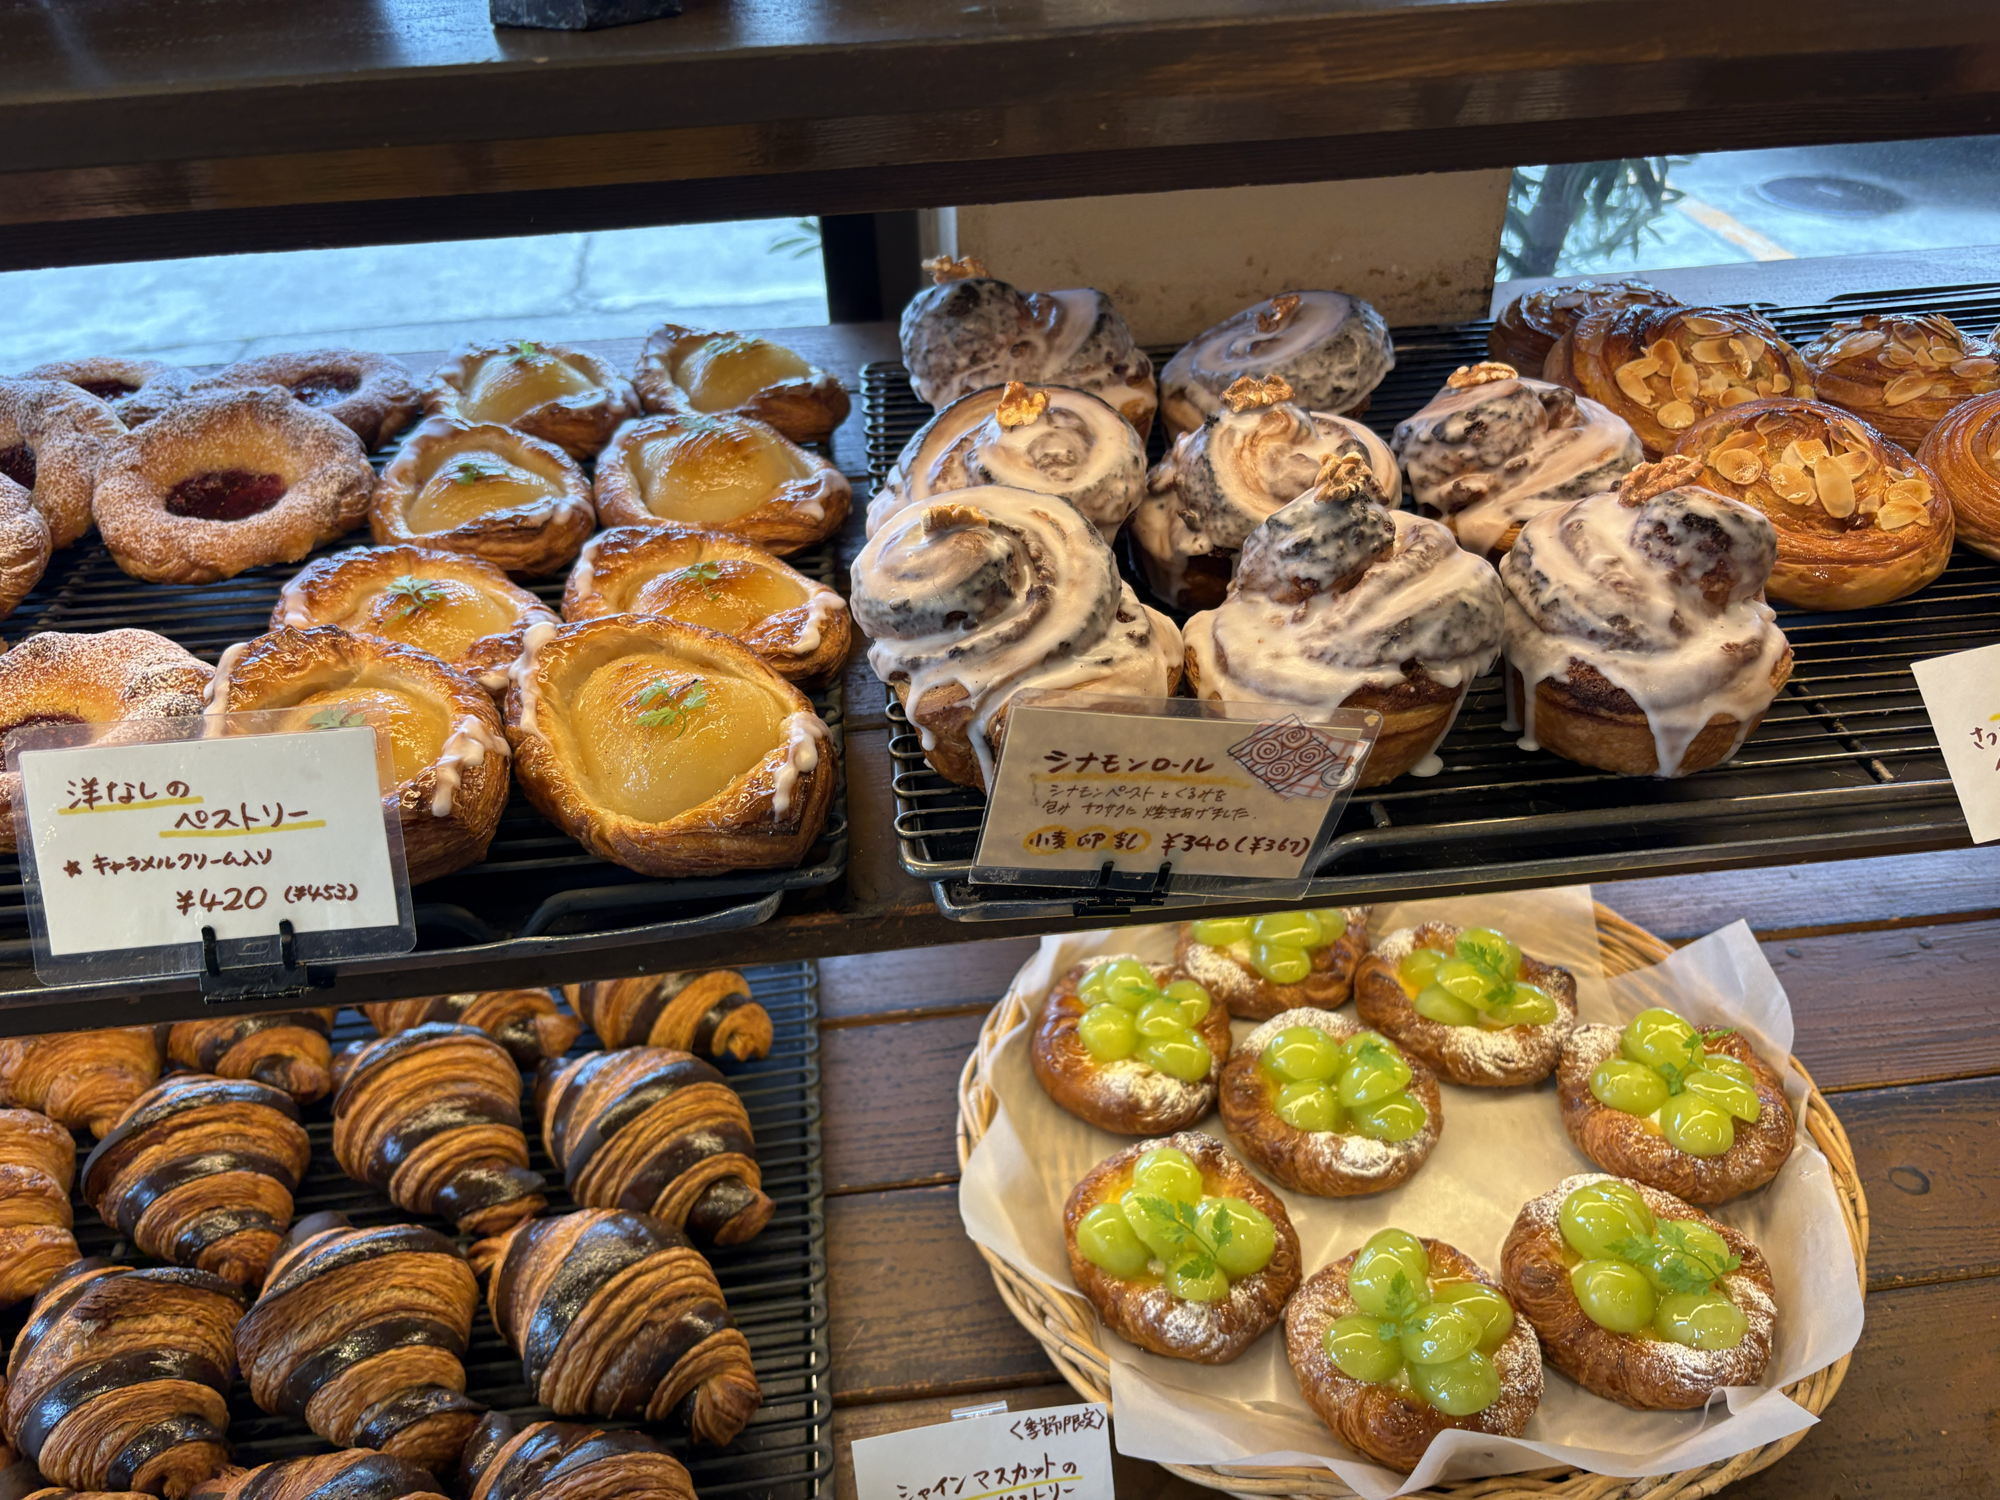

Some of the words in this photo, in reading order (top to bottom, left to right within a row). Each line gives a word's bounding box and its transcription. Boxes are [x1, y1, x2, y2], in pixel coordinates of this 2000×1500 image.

[1043, 750, 1214, 774] シナモンロール
[67, 777, 191, 810] 洋なしの
[174, 802, 309, 831] ペストリー
[1030, 830, 1067, 850] 小麦
[1077, 832, 1106, 849] 卵
[1113, 831, 1138, 850] 乳
[92, 848, 272, 876] キャラメルクリーム入り
[176, 886, 268, 916] ¥420
[284, 883, 358, 904] (¥453)
